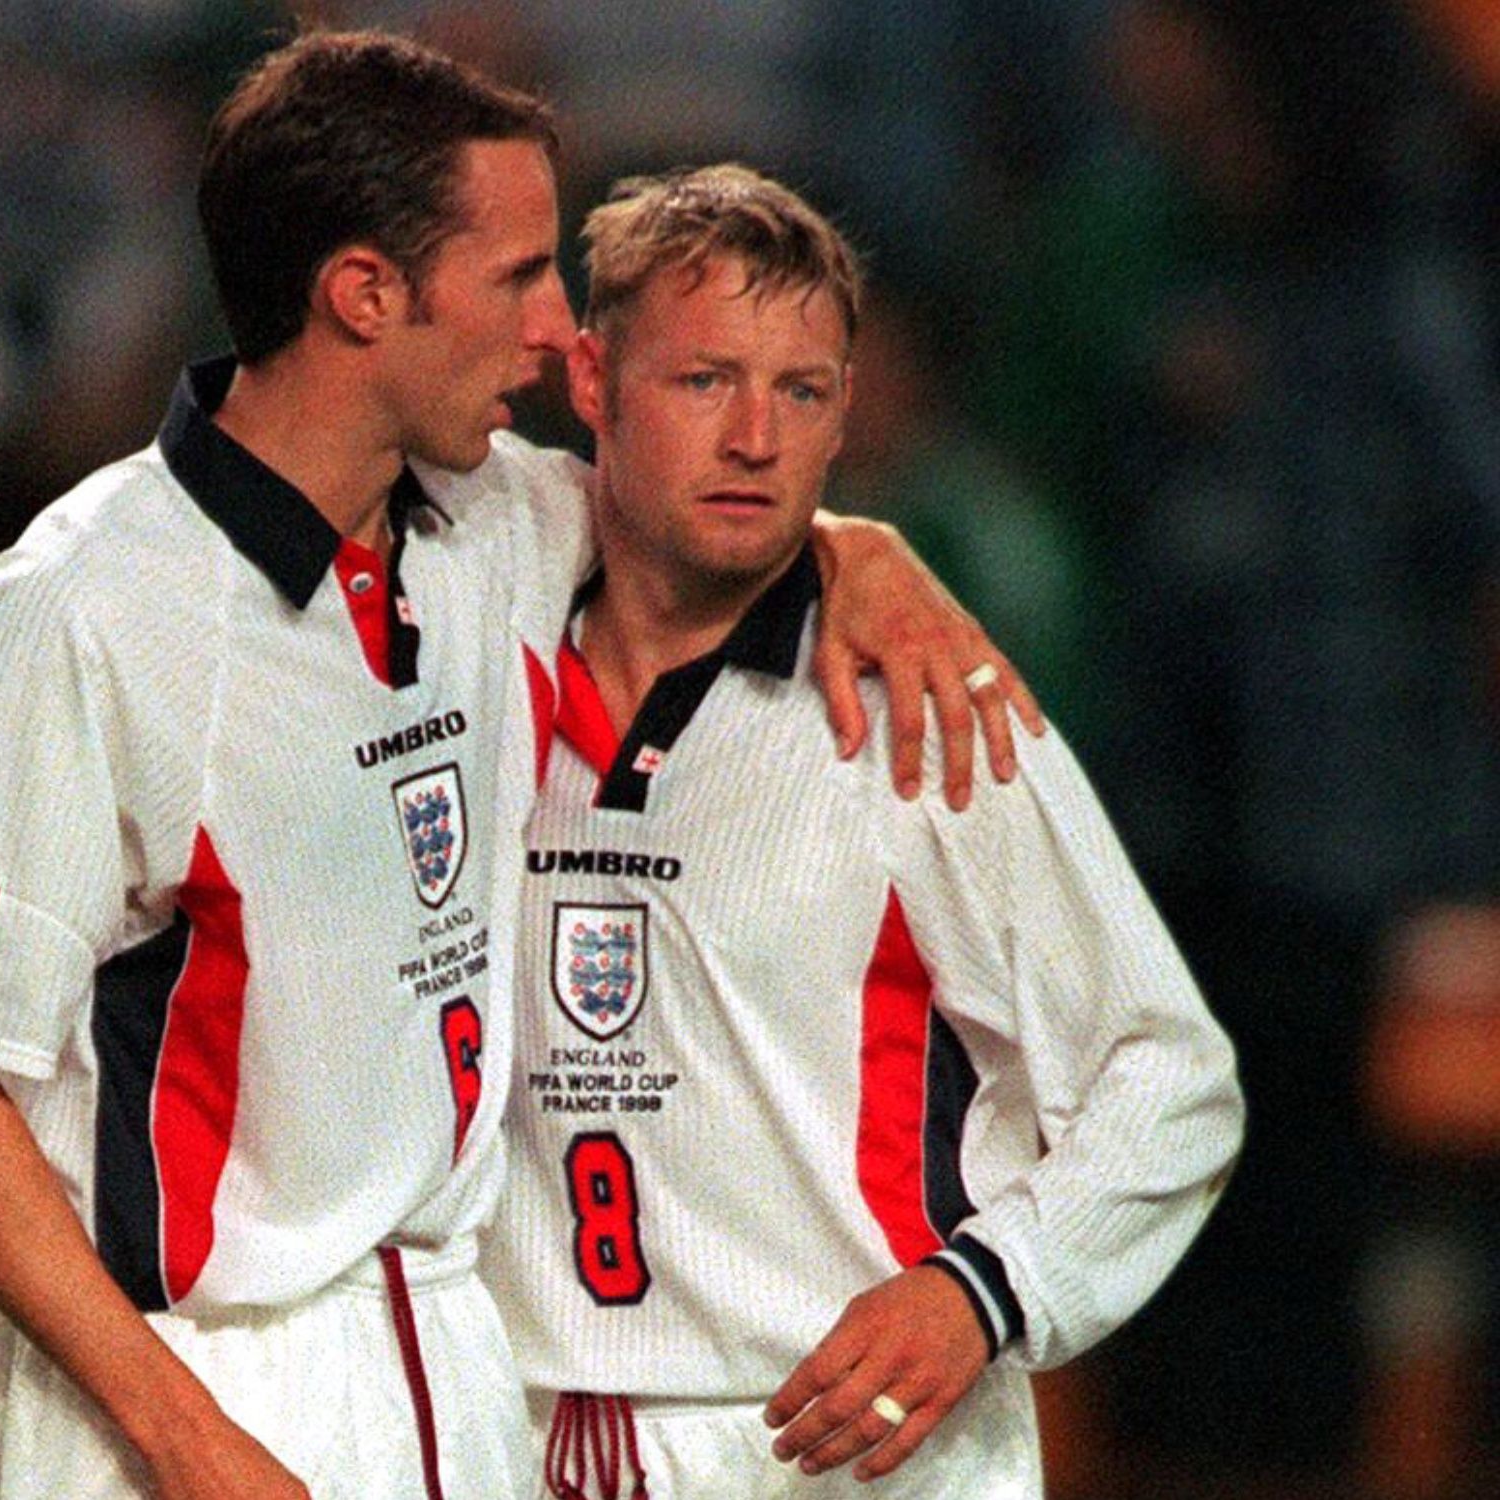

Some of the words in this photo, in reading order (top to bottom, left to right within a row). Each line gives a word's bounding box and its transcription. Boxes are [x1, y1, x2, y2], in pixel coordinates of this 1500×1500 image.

[355, 710, 467, 768] UMBRO
[526, 849, 681, 881] UMBRO
[550, 1048, 646, 1067] ENGLAND
[440, 994, 482, 1172] 6
[529, 1073, 561, 1091] FIFA
[566, 1073, 633, 1092] WORLD
[638, 1073, 678, 1092] CUP
[542, 1095, 612, 1113] FRANCE
[618, 1095, 663, 1113] 1998
[563, 1130, 652, 1308] 8
